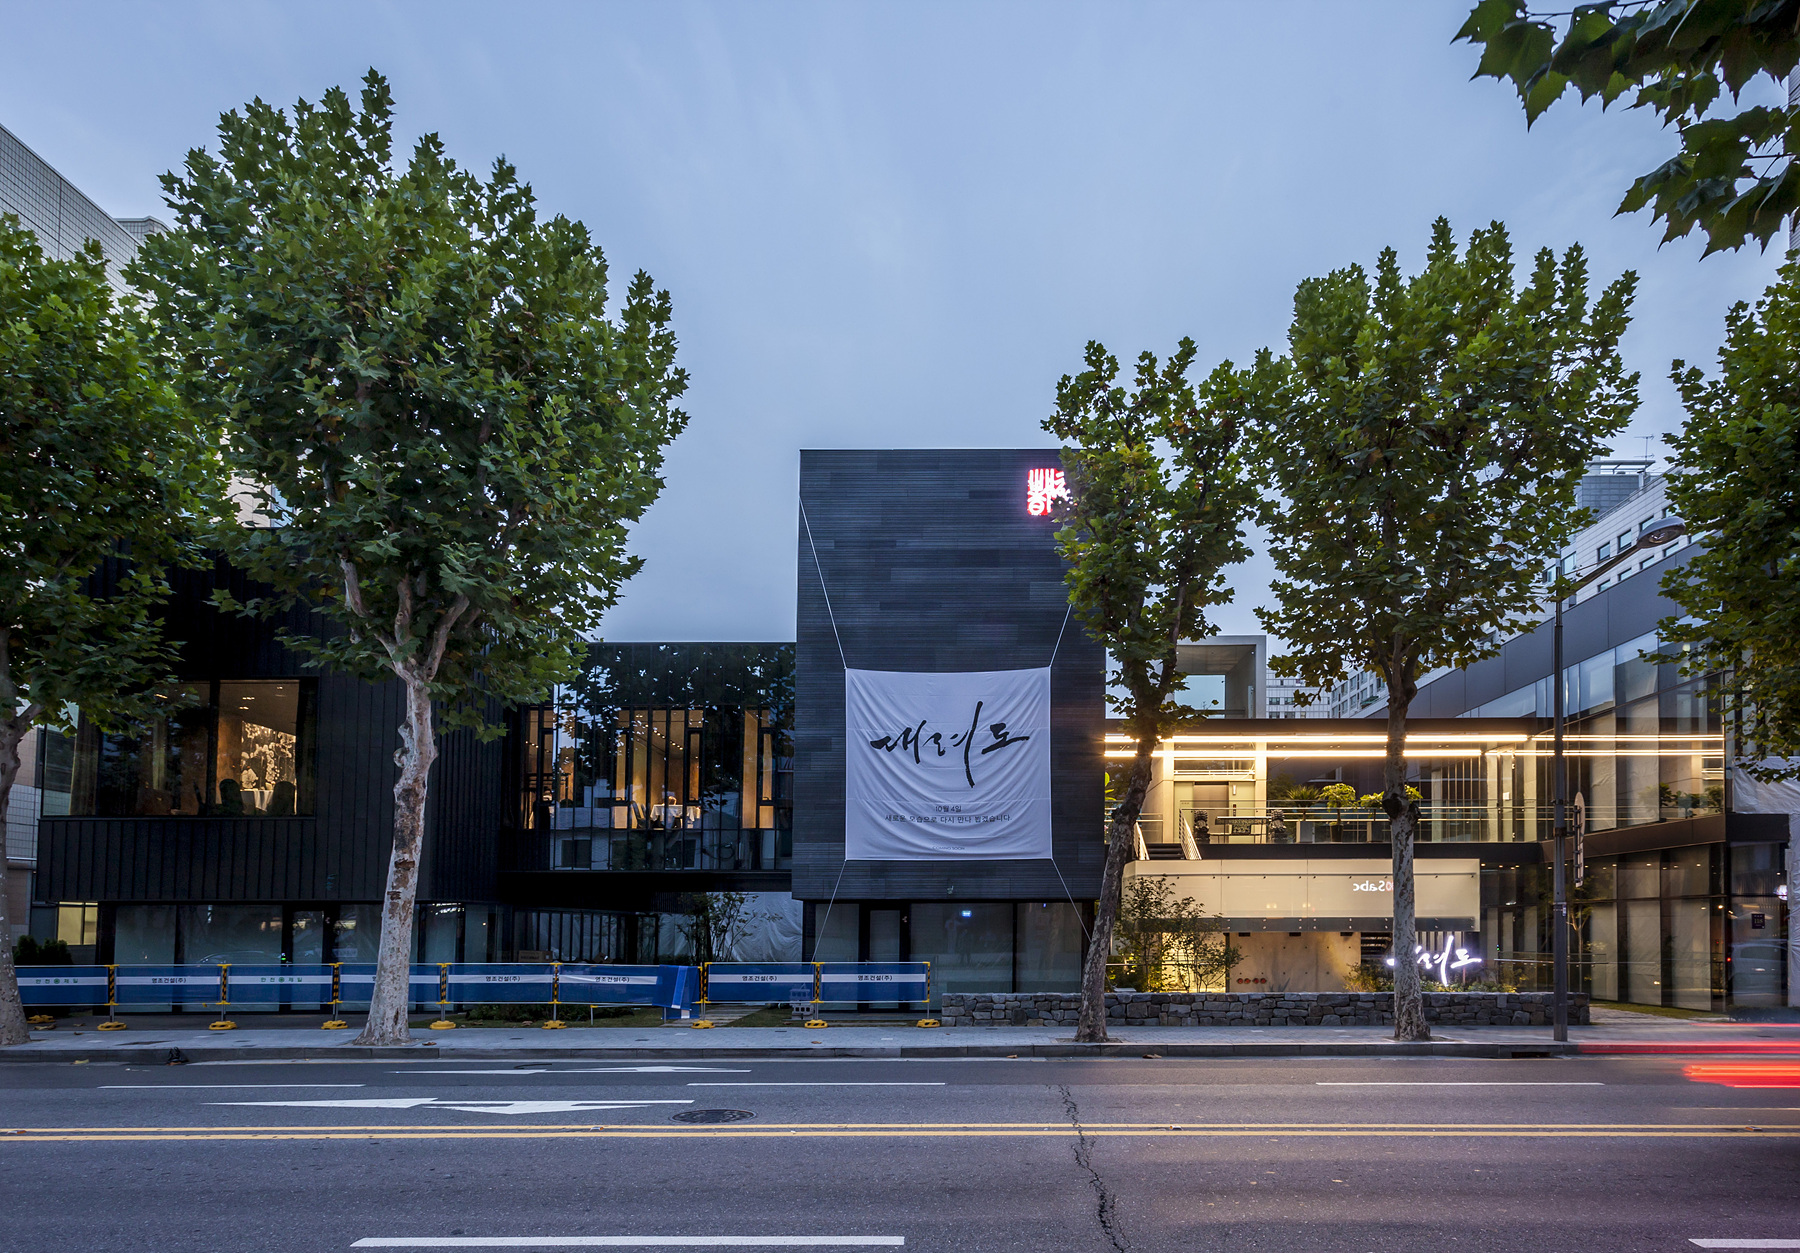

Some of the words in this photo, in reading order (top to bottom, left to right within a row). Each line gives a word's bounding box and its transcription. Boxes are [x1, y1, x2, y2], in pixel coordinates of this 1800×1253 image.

[935, 805, 949, 813] 10월
[951, 805, 962, 813] 4일
[885, 815, 906, 823] 새로운
[909, 815, 938, 823] 모습으로
[940, 816, 955, 824] 다시
[958, 816, 972, 824] 만나
